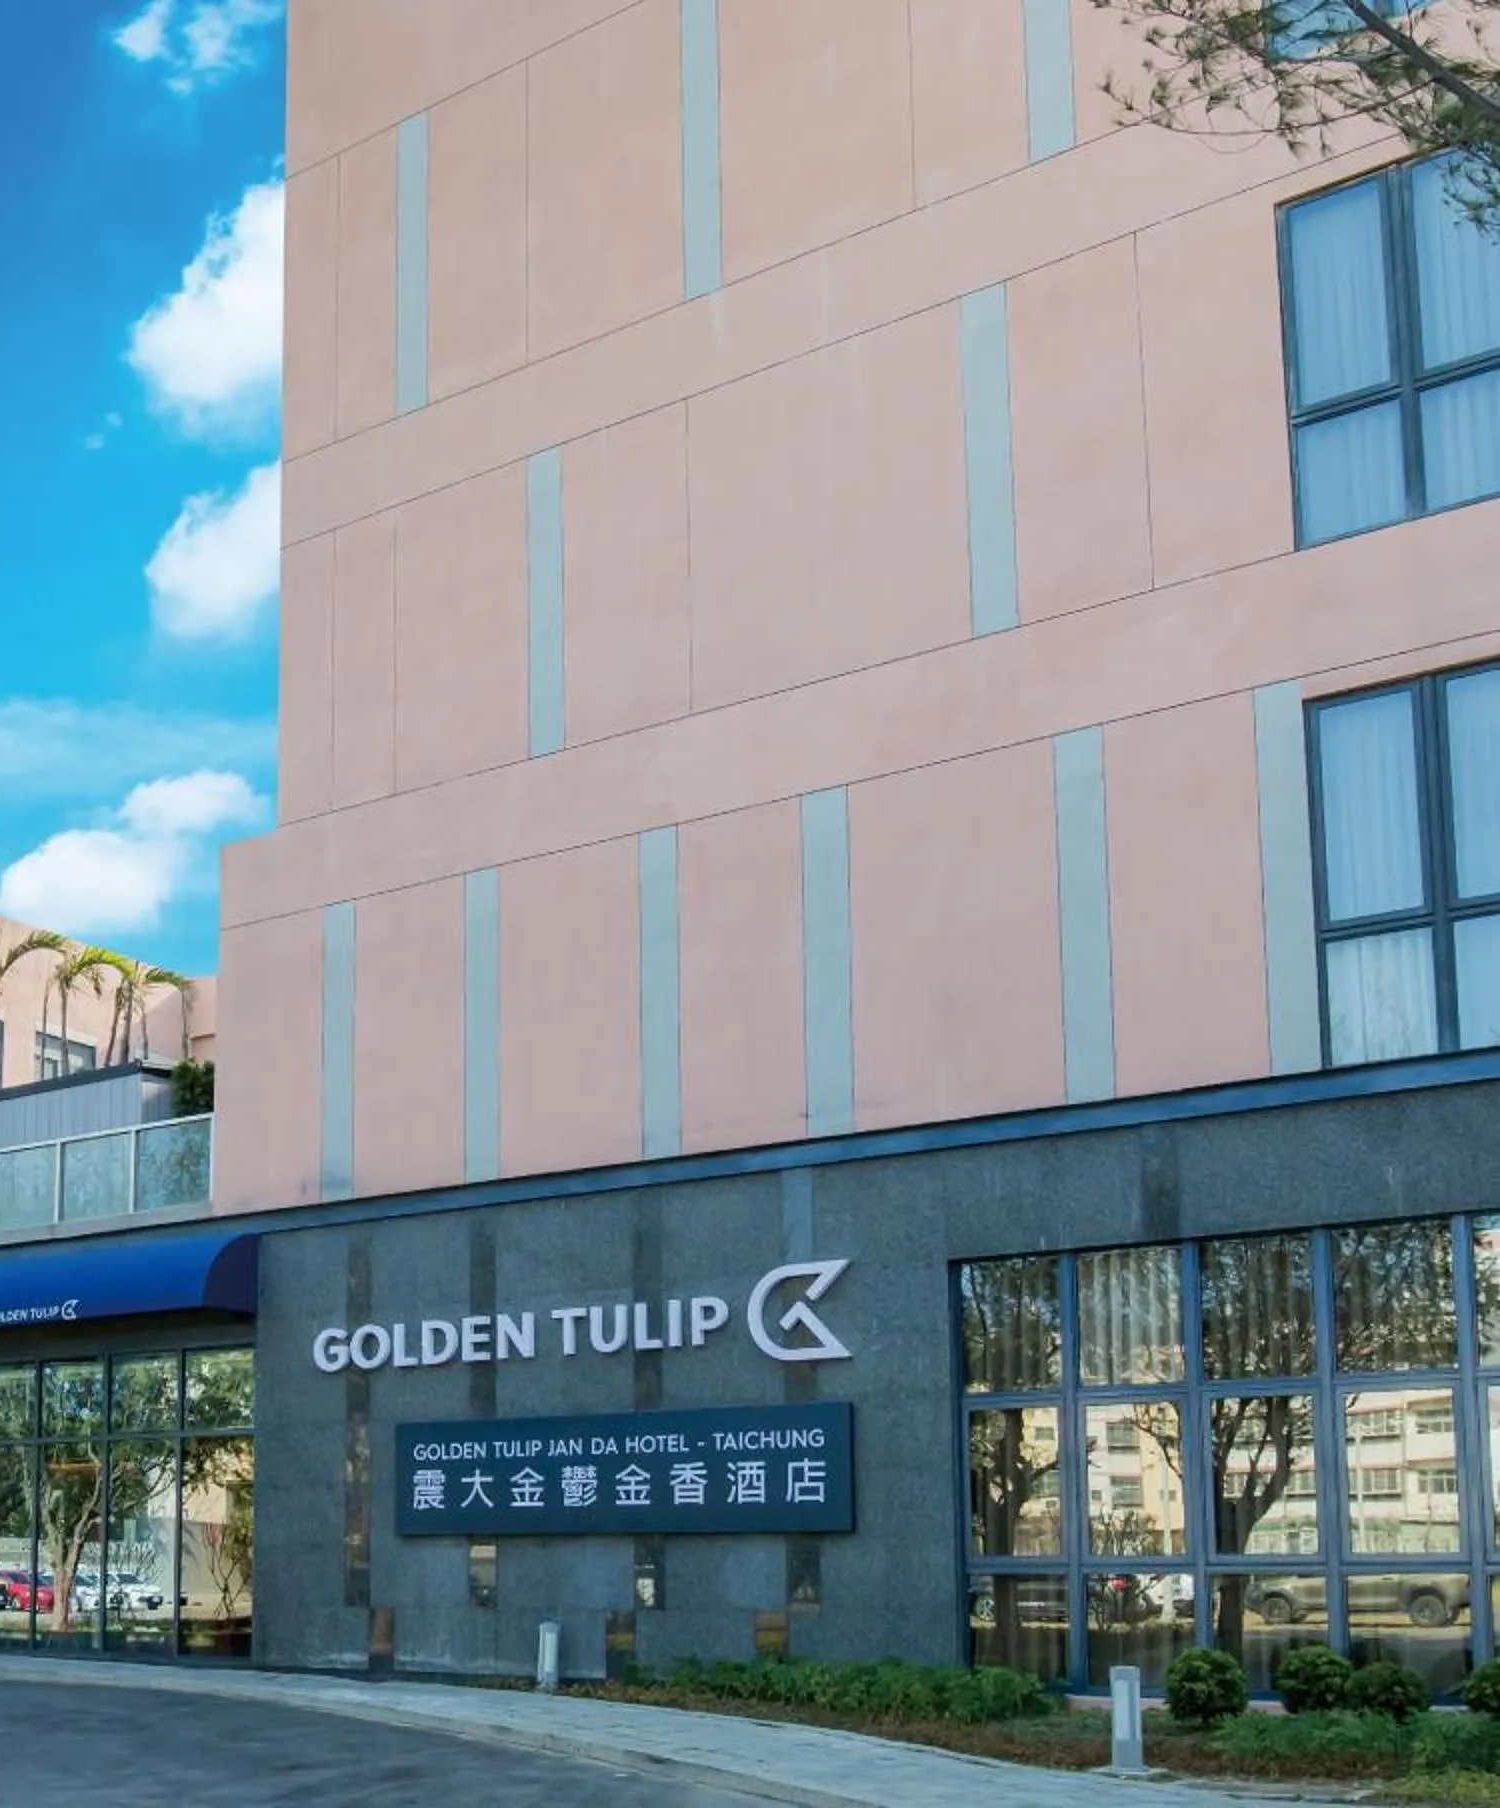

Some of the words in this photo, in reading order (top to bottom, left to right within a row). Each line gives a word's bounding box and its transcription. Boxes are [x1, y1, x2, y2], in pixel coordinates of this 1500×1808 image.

[30, 1305, 59, 1319] TULIP
[312, 1311, 536, 1373] GOLDEN
[551, 1296, 730, 1356] TULIP
[413, 1441, 487, 1461] GOLDEN
[492, 1439, 542, 1458] TULIP
[547, 1437, 583, 1457] JAN
[590, 1436, 619, 1455] DA
[625, 1434, 690, 1453] HOTEL
[711, 1428, 825, 1451] TAICHUNG
[412, 1457, 827, 1510] 震大金鬱金香酒店
